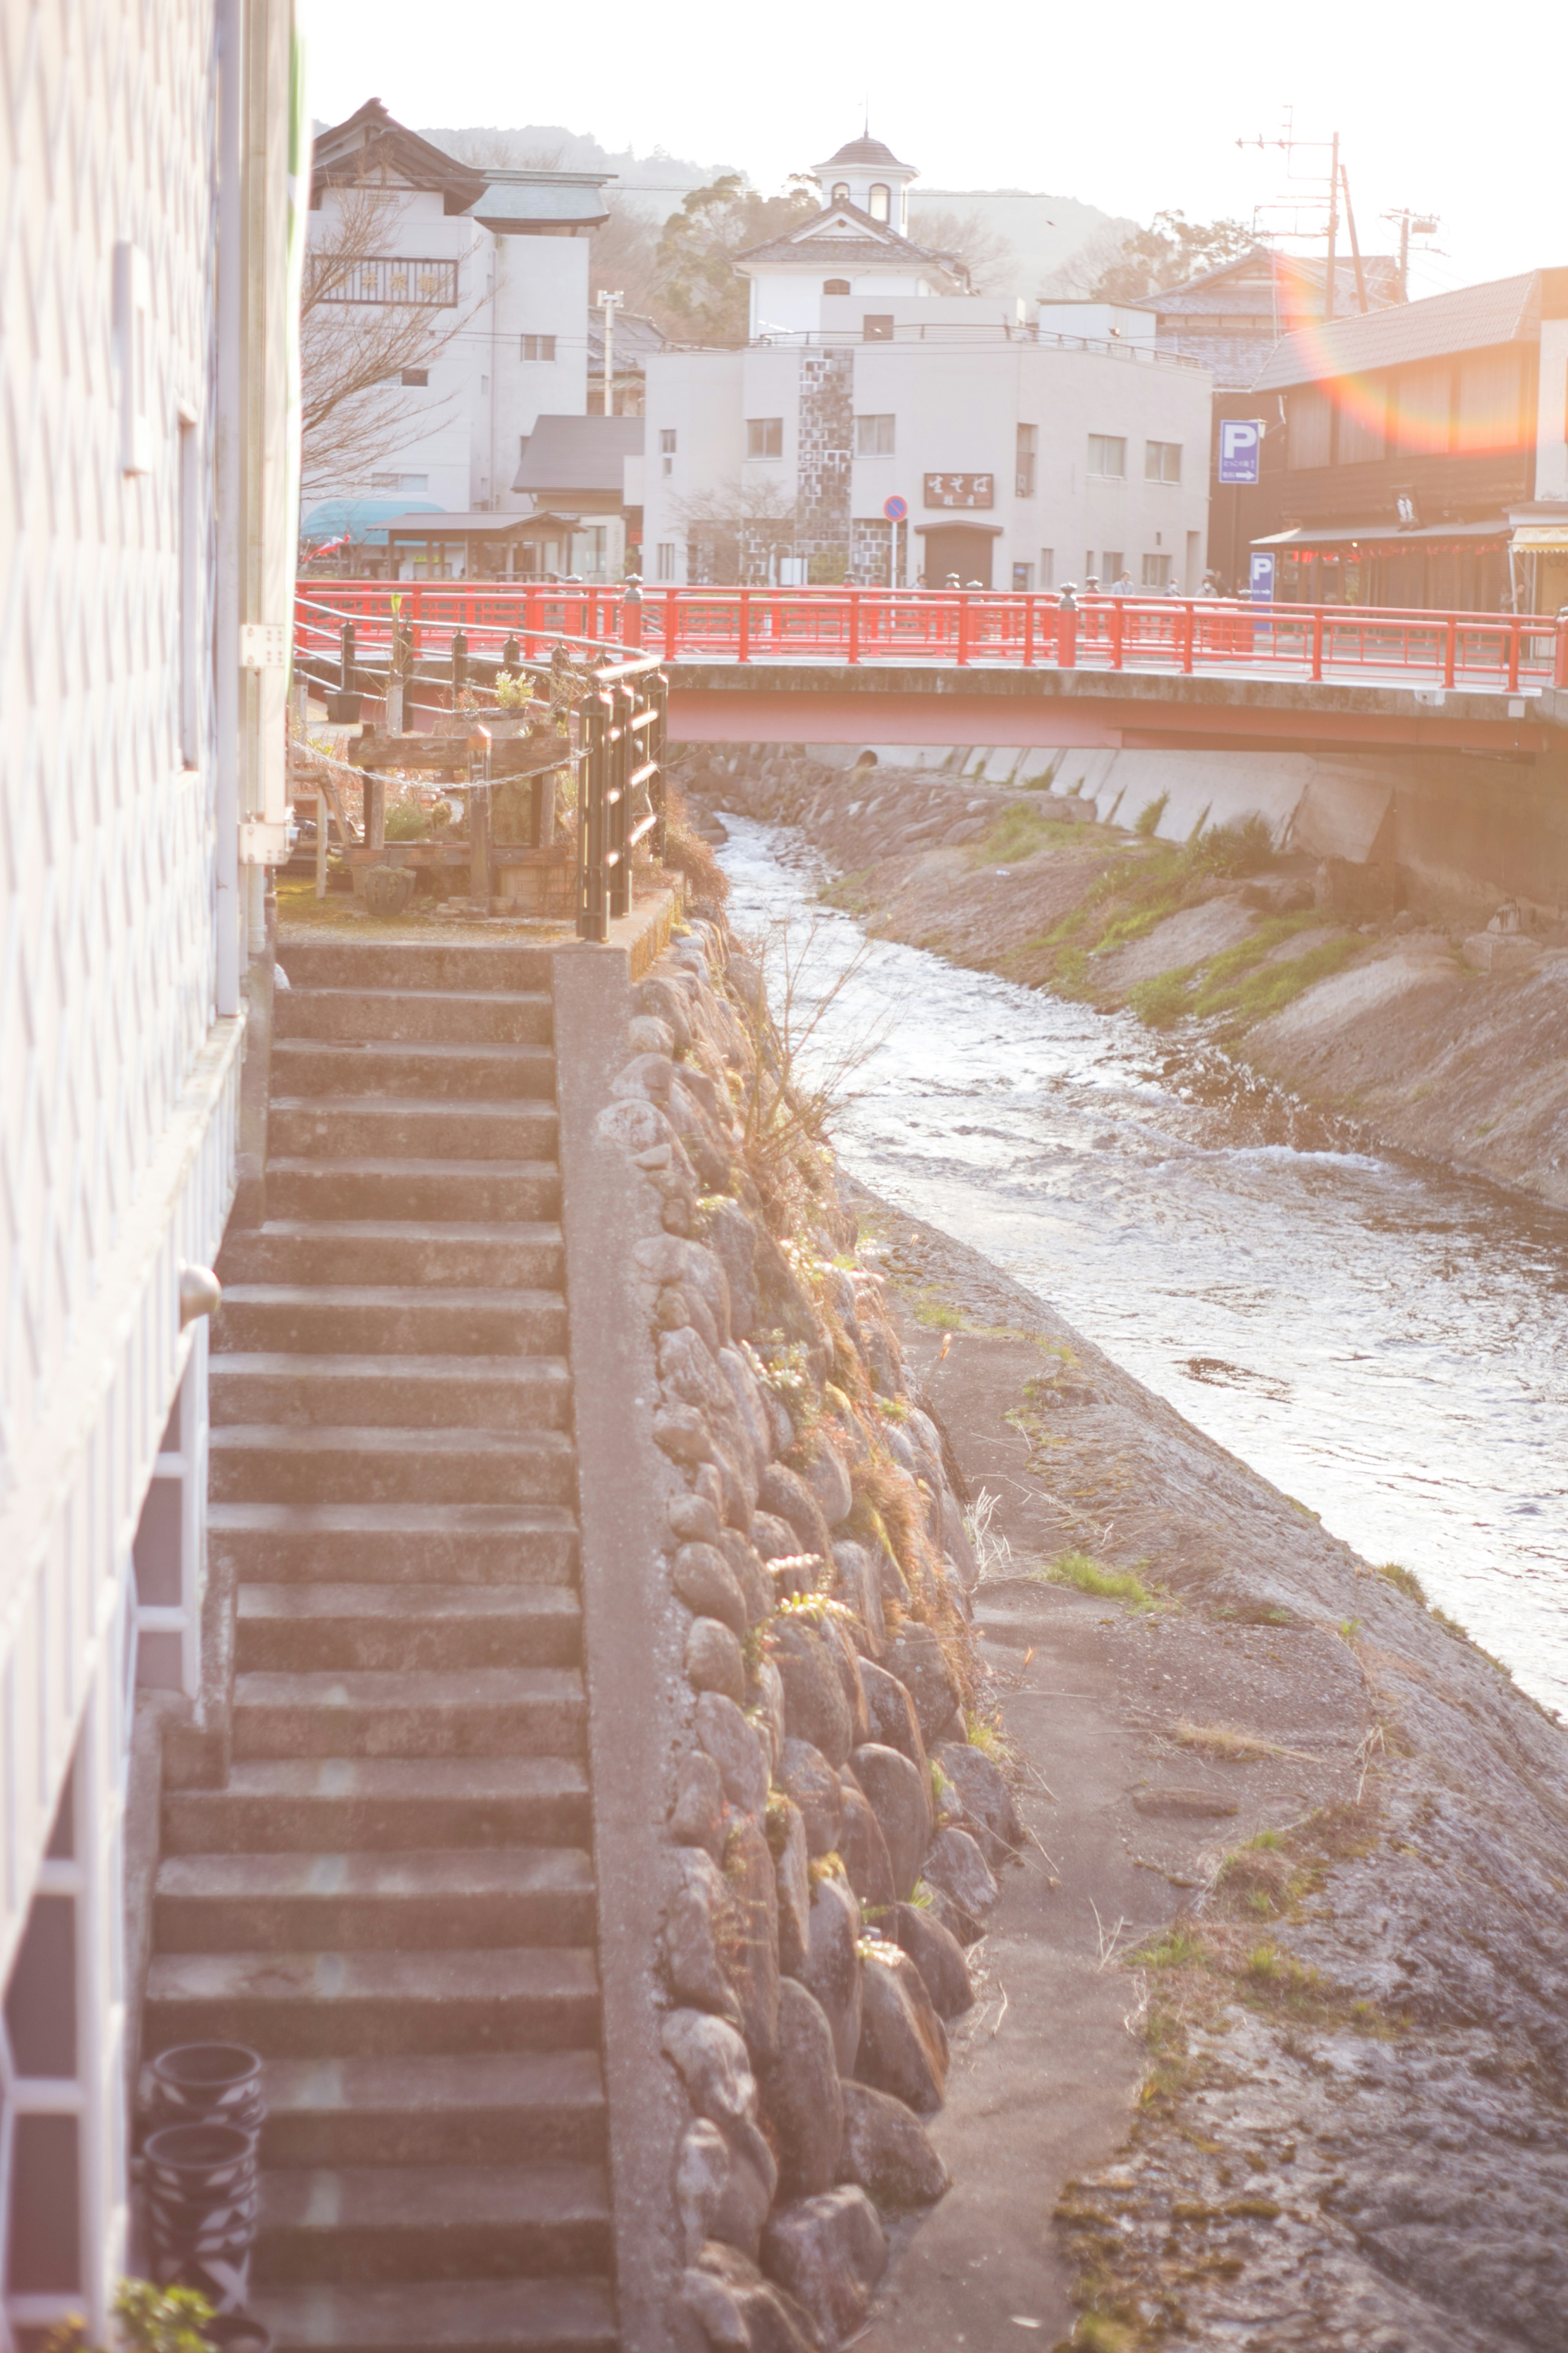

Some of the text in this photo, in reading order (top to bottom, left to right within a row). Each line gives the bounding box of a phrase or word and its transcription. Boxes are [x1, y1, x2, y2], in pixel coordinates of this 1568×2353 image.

[1225, 424, 1256, 458] P
[928, 475, 991, 493] 生そば
[1254, 558, 1272, 580] P
